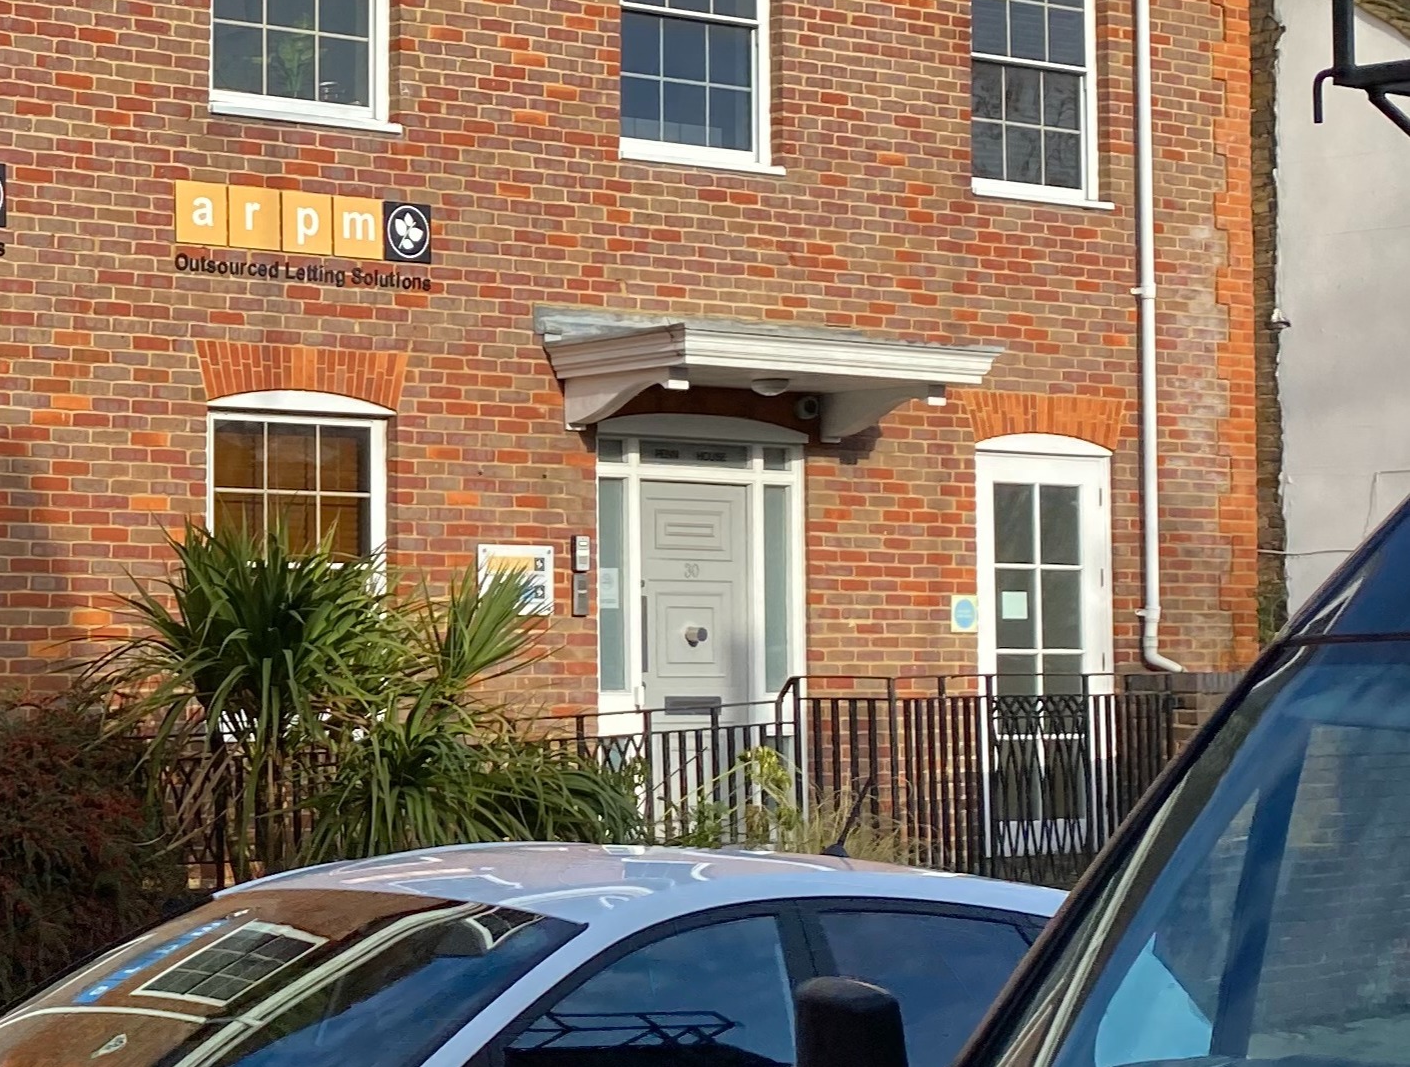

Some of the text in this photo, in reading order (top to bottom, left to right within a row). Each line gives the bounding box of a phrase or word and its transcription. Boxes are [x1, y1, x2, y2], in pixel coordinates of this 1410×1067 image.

[175, 253, 431, 291] Outsourced Letting Solutions
[684, 563, 700, 578] 30
